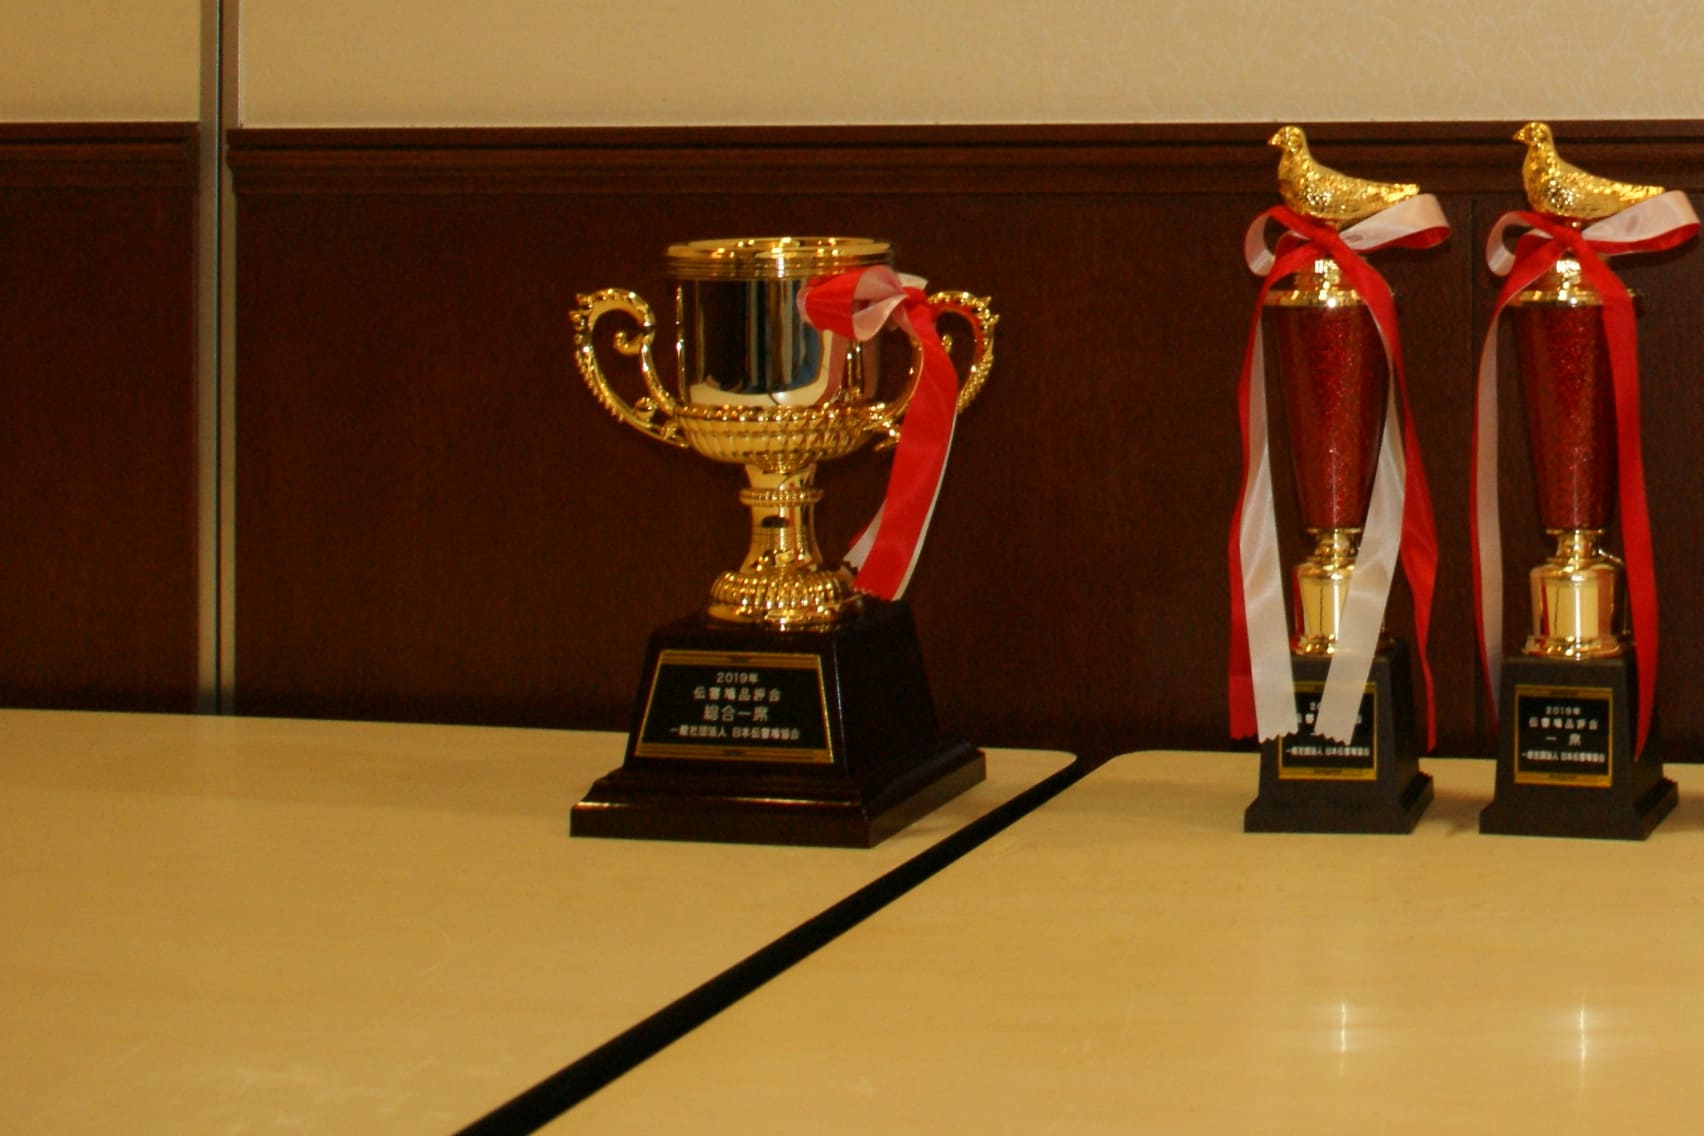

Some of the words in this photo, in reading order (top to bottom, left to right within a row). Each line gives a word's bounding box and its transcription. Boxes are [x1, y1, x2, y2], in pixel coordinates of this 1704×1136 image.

[716, 671, 759, 684] 2019年
[693, 686, 781, 703] 伝書鳩品評会
[703, 705, 769, 722] 総合一席
[1545, 706, 1581, 715] 2019年
[670, 724, 727, 738] 一般社団法人
[732, 726, 800, 741] 日本伝書鳩協会
